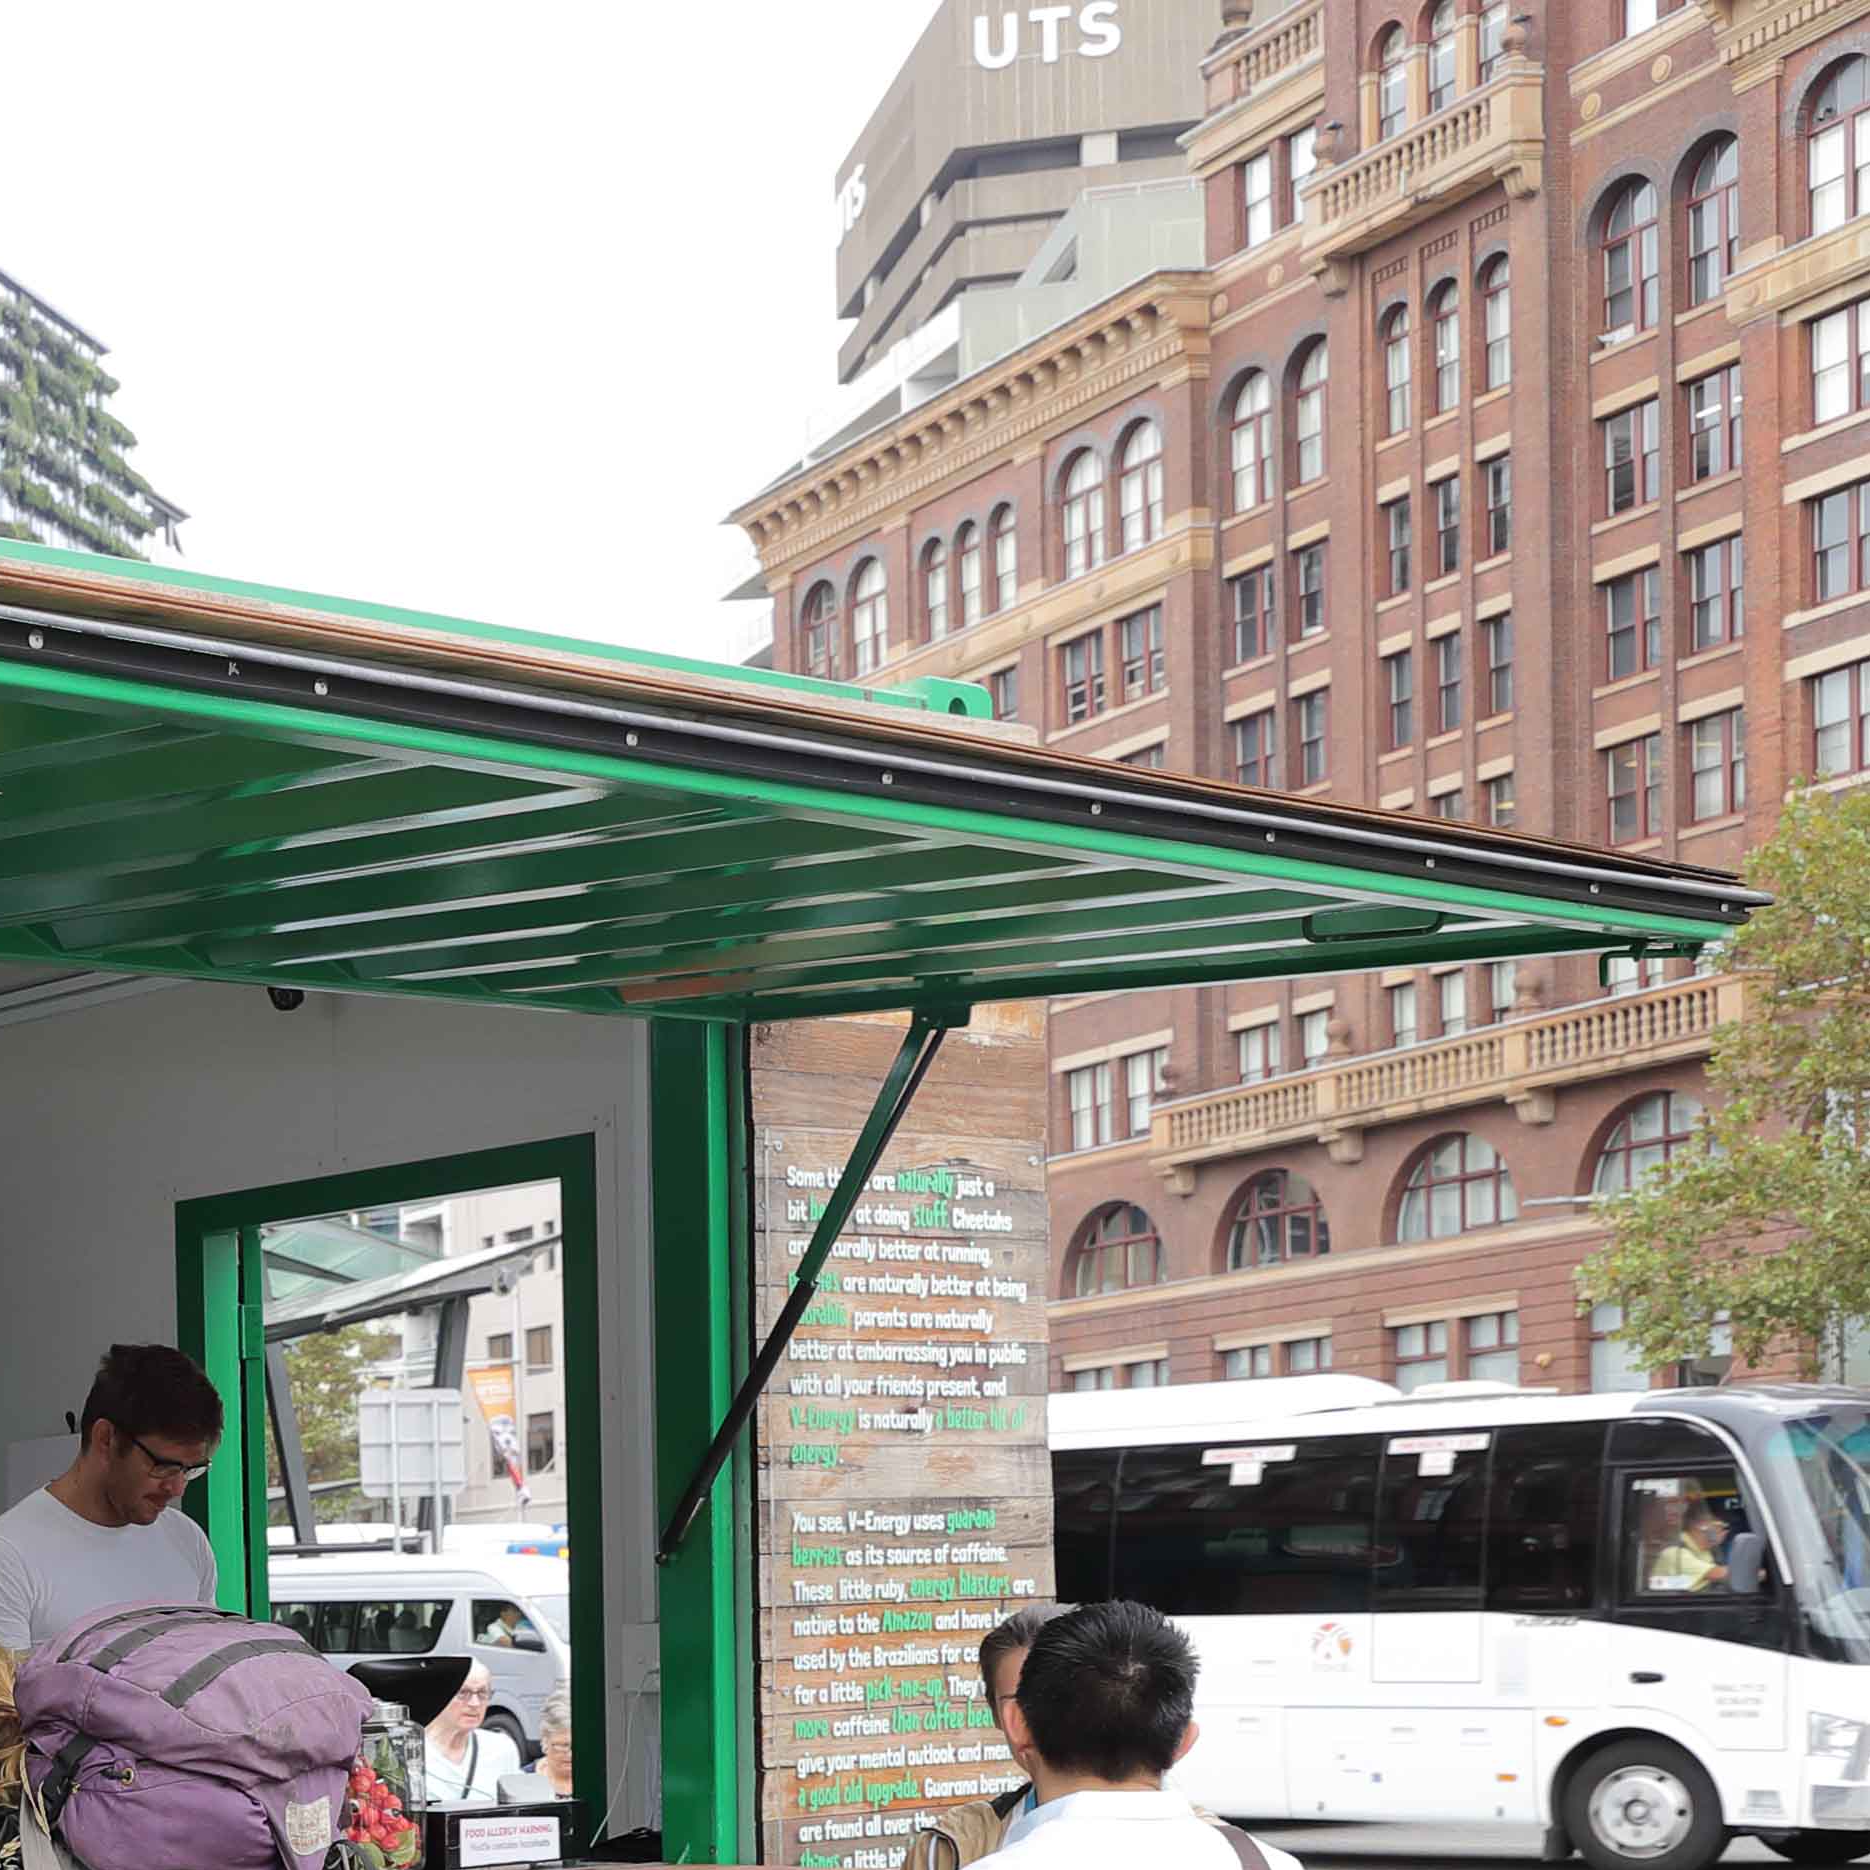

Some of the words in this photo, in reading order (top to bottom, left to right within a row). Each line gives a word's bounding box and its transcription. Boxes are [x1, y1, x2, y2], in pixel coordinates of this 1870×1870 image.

[973, 1, 1121, 70] UTS
[787, 1165, 825, 1188] Some
[872, 1174, 896, 1191] are
[897, 1167, 953, 1198] naturally
[956, 1174, 984, 1200] just
[985, 1182, 995, 1197] a
[787, 1199, 808, 1222] bit
[855, 1204, 873, 1224] at
[873, 1204, 910, 1231] doing
[952, 1207, 1012, 1232] Cheetahs
[878, 1238, 922, 1260] better
[924, 1241, 940, 1261] at
[843, 1276, 867, 1292] are
[868, 1272, 930, 1299] naturally
[931, 1273, 974, 1296] better
[975, 1275, 992, 1297] at
[993, 1275, 1028, 1302] being
[853, 1306, 908, 1332] parents
[910, 1311, 933, 1328] are
[934, 1308, 994, 1334] naturally
[789, 1338, 836, 1360] better
[837, 1341, 855, 1360] at
[855, 1341, 948, 1367] embarrassing
[948, 1346, 973, 1367] you
[974, 1341, 987, 1362] in
[988, 1342, 1027, 1368] public
[790, 1372, 823, 1395] with
[824, 1373, 842, 1395] all
[842, 1378, 873, 1399] your
[875, 1374, 925, 1396] friends
[926, 1376, 981, 1401] present,
[983, 1376, 1008, 1397] and
[857, 1407, 871, 1429] is
[873, 1407, 934, 1434] naturally
[947, 1400, 987, 1430] better
[792, 1511, 817, 1533] You
[847, 1510, 911, 1537] V-Energy
[913, 1514, 946, 1531] uses
[947, 1508, 997, 1535] guarana
[792, 1536, 843, 1567] berries
[845, 1550, 863, 1566] as
[865, 1544, 885, 1565] its
[886, 1548, 933, 1565] source
[934, 1543, 950, 1564] of
[793, 1579, 834, 1602] These
[838, 1576, 873, 1600] little
[910, 1575, 956, 1602] energy
[958, 1567, 1011, 1597] blasters
[1012, 1578, 1036, 1595] are
[793, 1613, 837, 1637] native
[838, 1613, 854, 1635] to
[856, 1611, 880, 1634] the
[882, 1608, 933, 1632] Amazon
[935, 1608, 959, 1630] and
[960, 1608, 994, 1630] have
[793, 1647, 828, 1671] used
[828, 1647, 847, 1674] by
[848, 1646, 873, 1669] the
[873, 1643, 940, 1668] Brazilians
[941, 1643, 961, 1664] for
[794, 1683, 817, 1706] for
[818, 1687, 829, 1703] a
[830, 1679, 865, 1704] little
[795, 1719, 829, 1740] more
[832, 1713, 891, 1737] caffeine
[891, 1704, 920, 1733] than
[923, 1700, 965, 1730] coffee
[797, 1751, 826, 1780] give
[826, 1753, 858, 1777] your
[858, 1745, 906, 1769] mental
[907, 1742, 957, 1767] outlook
[956, 1740, 981, 1763] and
[797, 1786, 806, 1808] a
[809, 1775, 840, 1812] good
[843, 1775, 864, 1804] old
[924, 1775, 979, 1799] Guarana
[799, 1823, 823, 1843] are
[824, 1815, 864, 1841] found
[865, 1814, 882, 1837] all
[883, 1818, 913, 1835] over
[913, 1811, 938, 1833] the
[854, 1847, 888, 1869] little
[888, 1846, 907, 1868] bit
